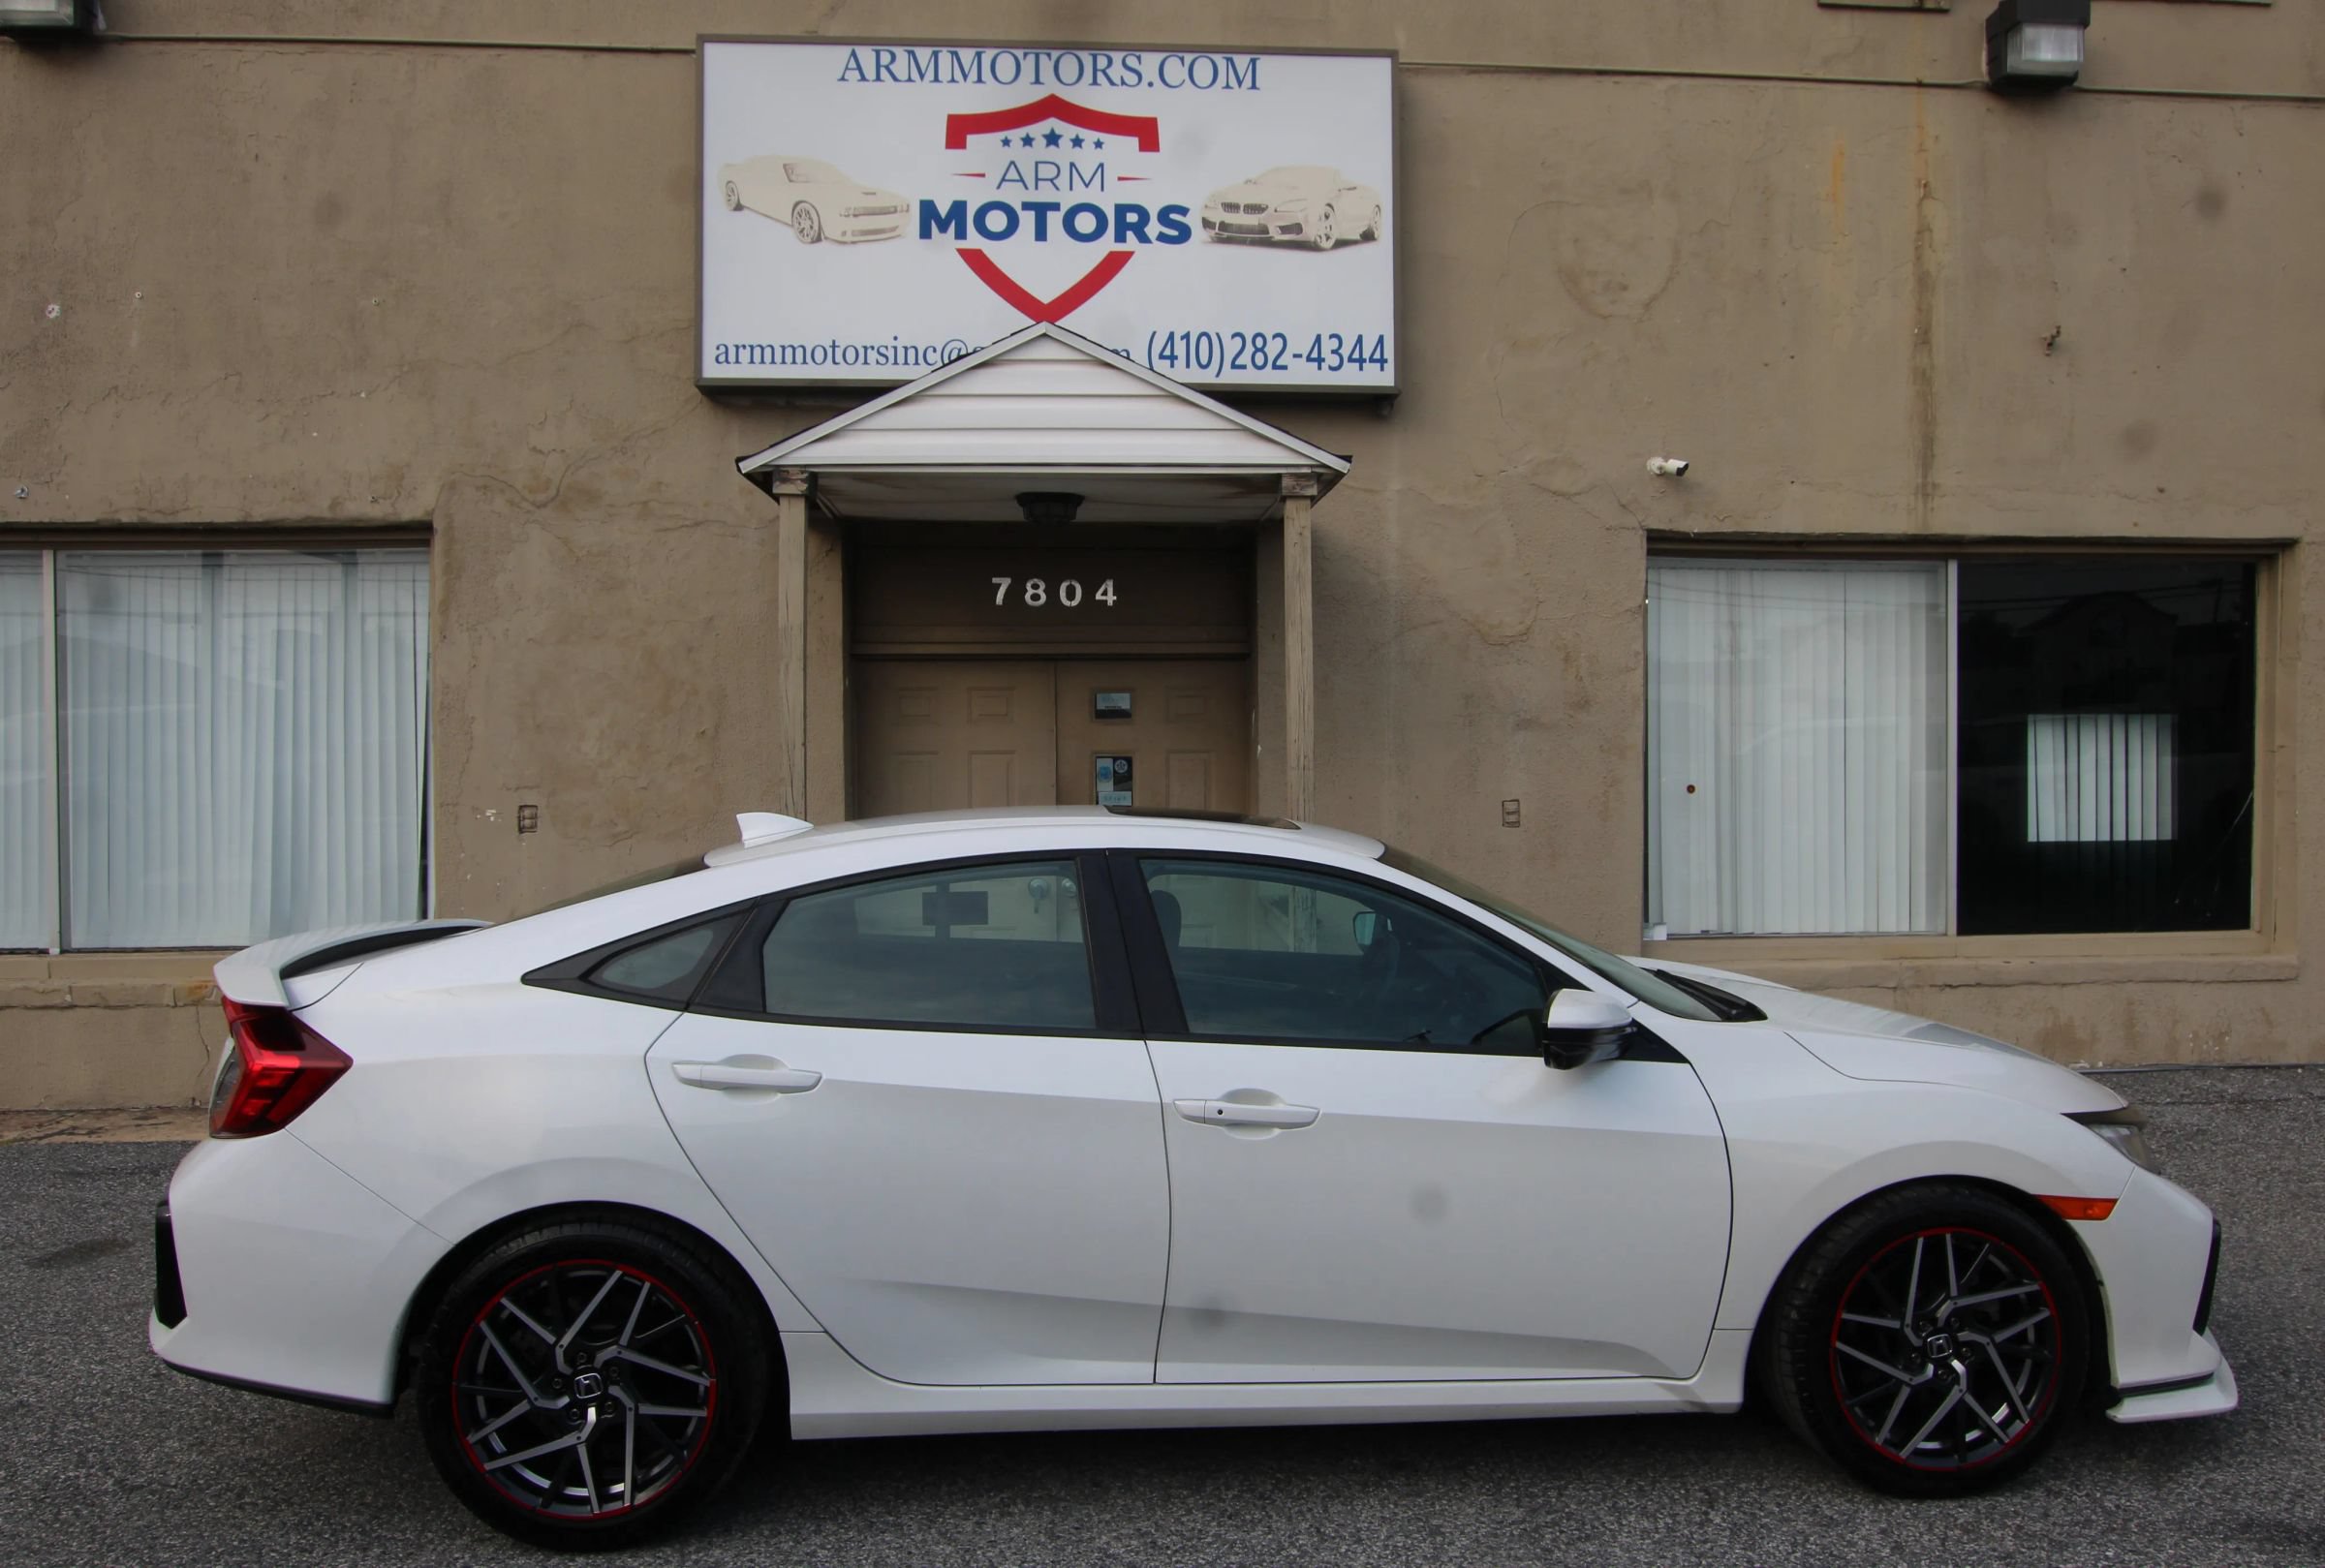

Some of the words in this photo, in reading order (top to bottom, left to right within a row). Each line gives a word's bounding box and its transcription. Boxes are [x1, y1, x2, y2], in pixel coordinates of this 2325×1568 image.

[837, 48, 1261, 91] ARMMOTORS.COM
[996, 160, 1106, 193] ARM
[918, 200, 1192, 246] MOTORS
[1147, 330, 1388, 378] (410)282-4344
[991, 576, 1117, 607] 7804
